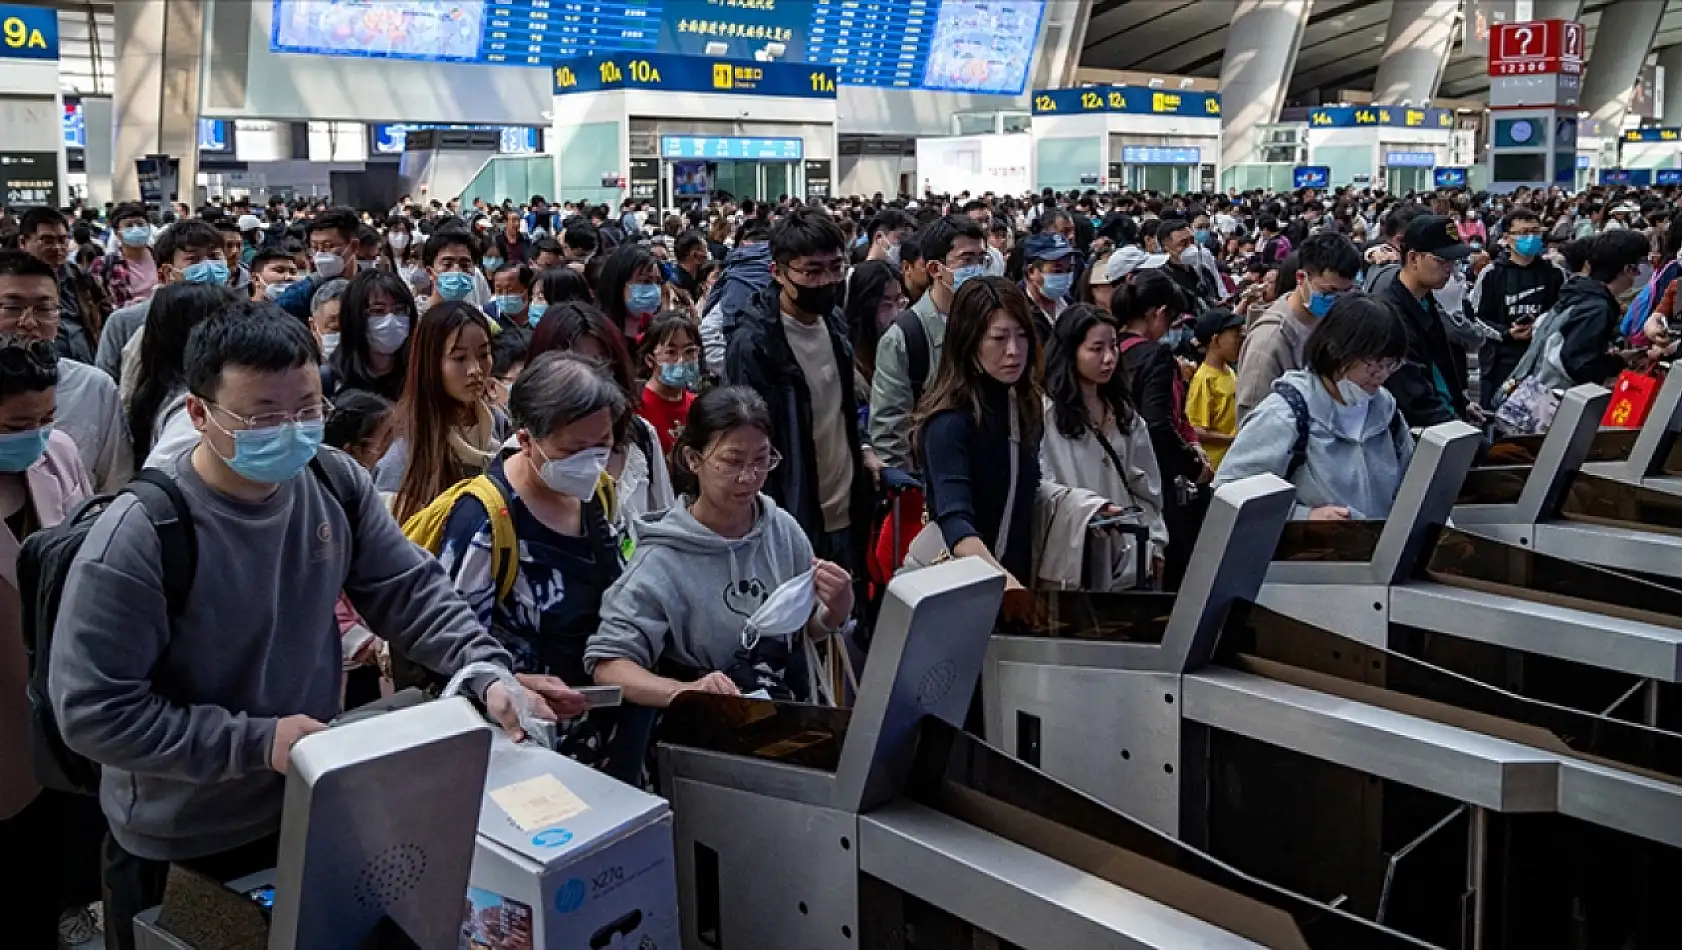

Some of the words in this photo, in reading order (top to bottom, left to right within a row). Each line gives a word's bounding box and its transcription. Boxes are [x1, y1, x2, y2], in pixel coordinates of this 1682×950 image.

[3, 16, 47, 49] 9A
[556, 65, 577, 88] 10A
[600, 60, 622, 84] 10A
[629, 60, 661, 83] 10A
[1501, 61, 1545, 73] 12306
[809, 72, 835, 92] 11A
[1036, 95, 1056, 111] 12A
[1081, 92, 1104, 109] 12A
[1108, 92, 1126, 108] 12A
